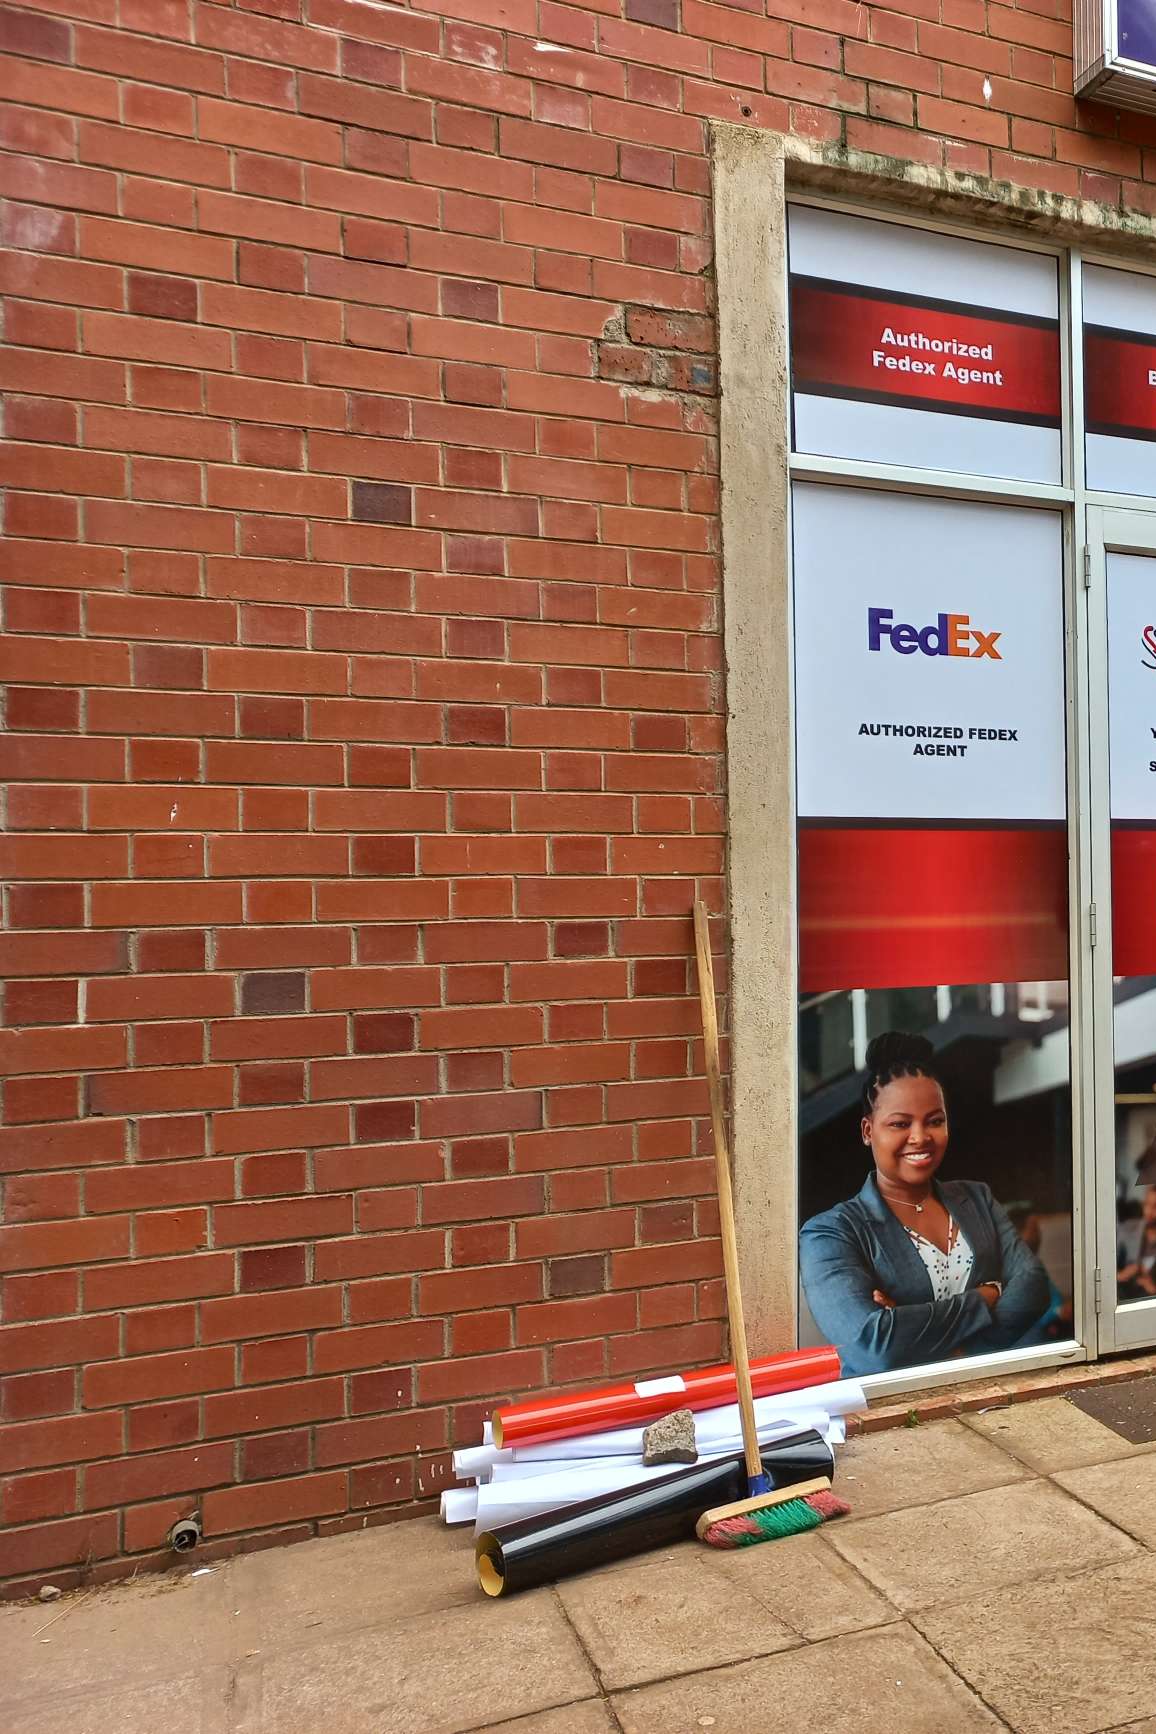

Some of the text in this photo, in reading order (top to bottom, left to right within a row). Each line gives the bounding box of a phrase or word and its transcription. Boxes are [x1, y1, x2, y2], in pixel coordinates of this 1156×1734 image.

[881, 327, 993, 361] Authorized
[872, 351, 1003, 387] Fedex Agent
[868, 607, 1003, 660] FedEx
[858, 723, 1018, 741] AUTHORIZED FEDEX
[913, 744, 967, 757] AGENT
